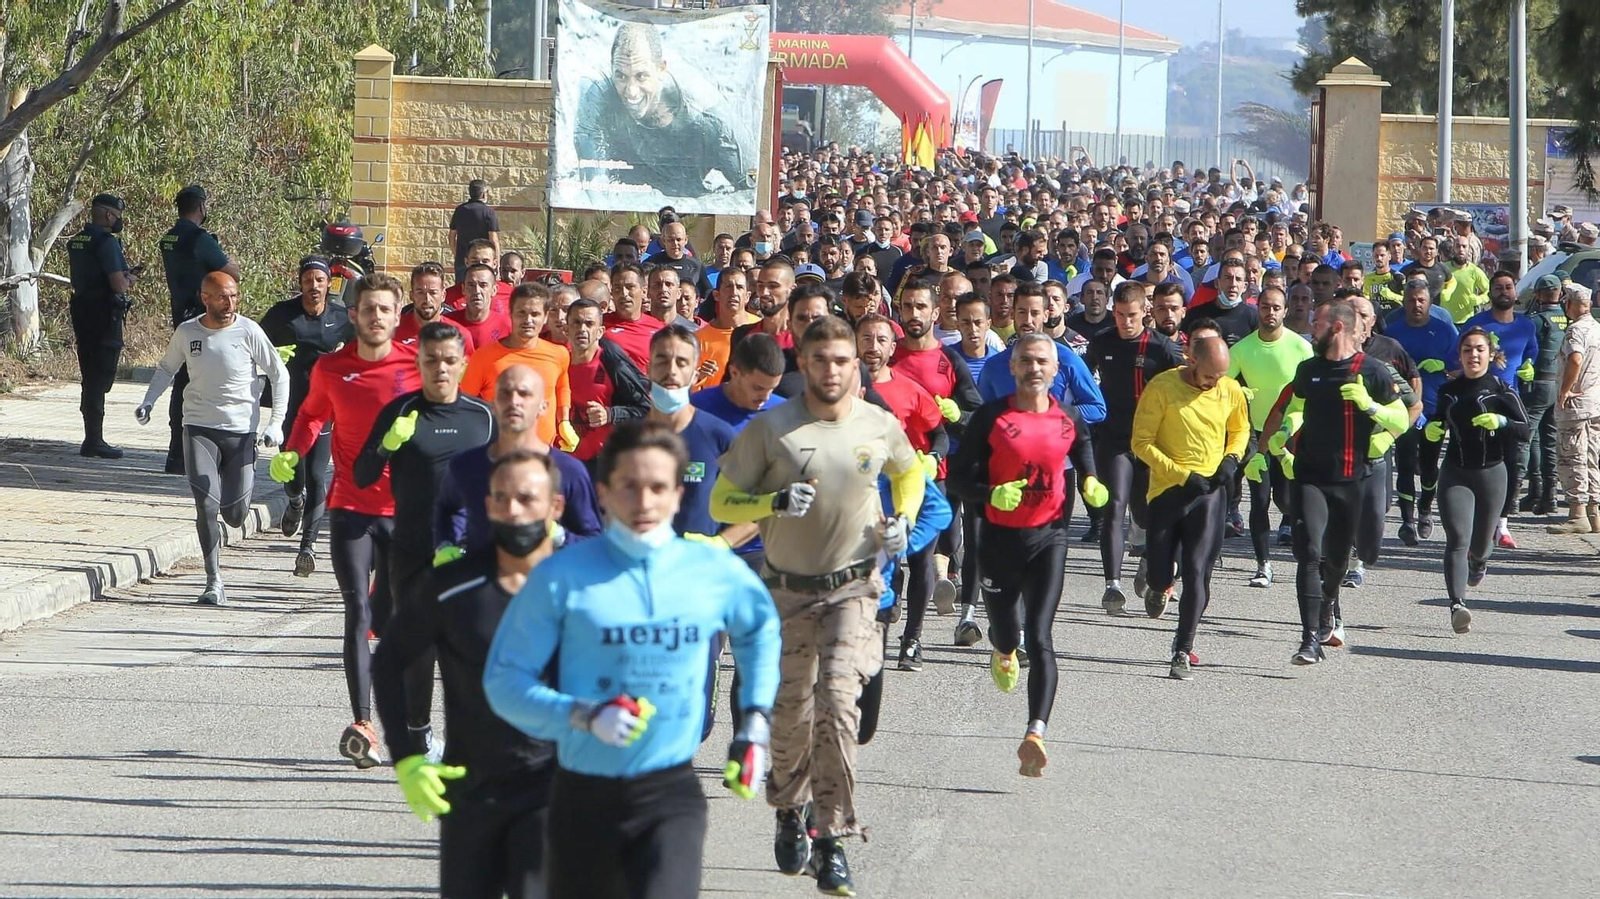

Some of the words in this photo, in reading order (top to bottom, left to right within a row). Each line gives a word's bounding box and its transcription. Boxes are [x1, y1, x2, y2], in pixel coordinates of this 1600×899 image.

[778, 38, 830, 49] MARINA
[800, 447, 817, 475] 7
[601, 618, 699, 650] nerja
